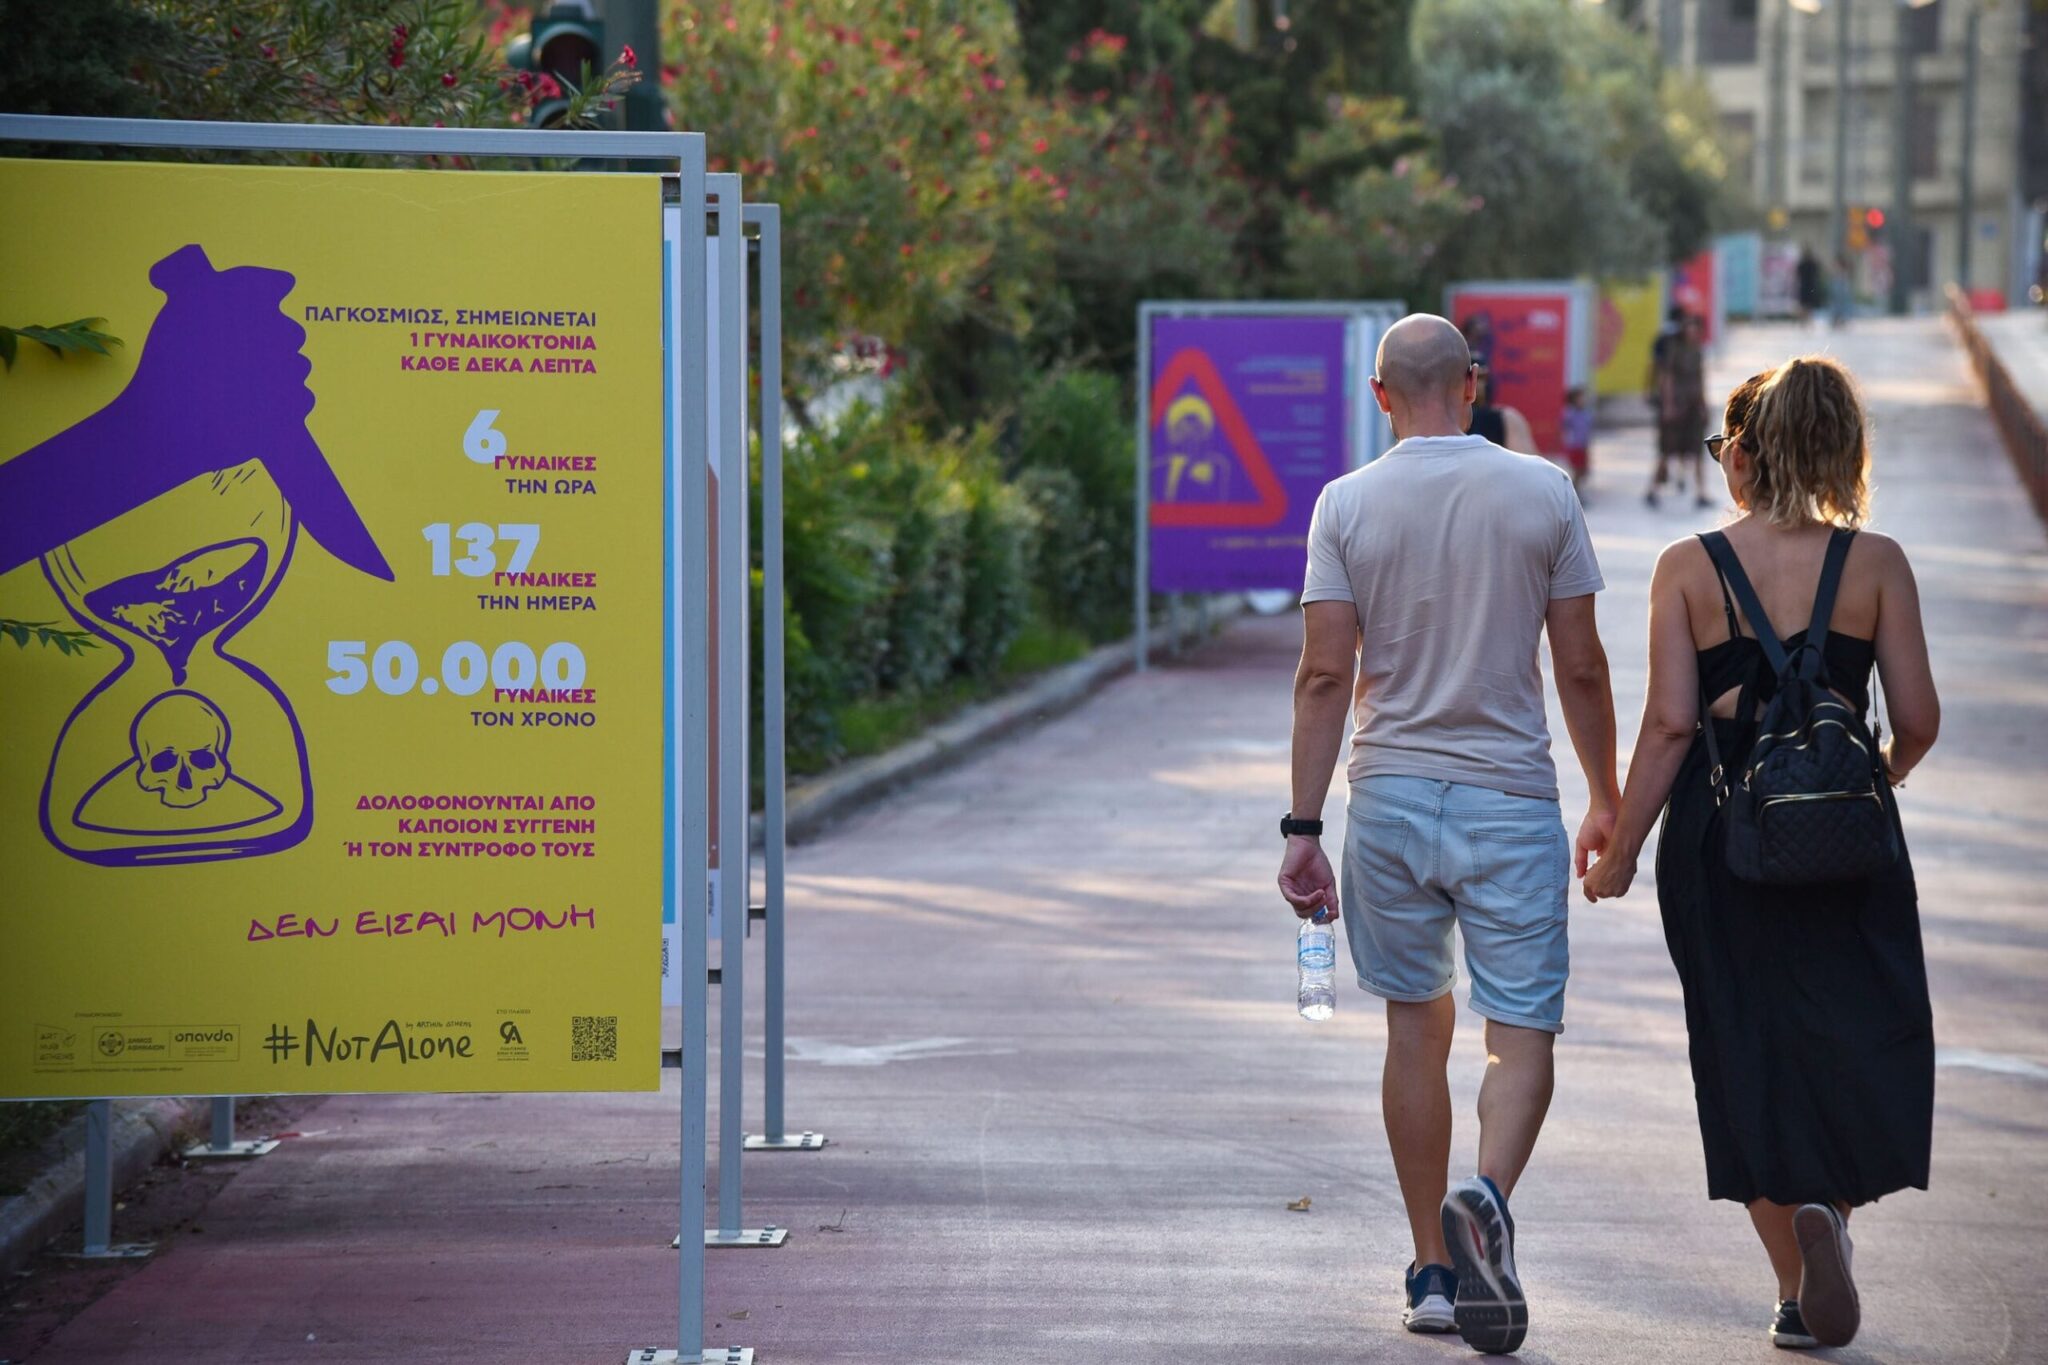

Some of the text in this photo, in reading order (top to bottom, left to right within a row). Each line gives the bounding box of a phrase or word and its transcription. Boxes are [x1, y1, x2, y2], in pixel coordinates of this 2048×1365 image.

[305, 307, 597, 327] ΠΑΓΚΟΣΜΙΩΣ, ΣΗΜΕΙΩΝΕΤΑΙ
[410, 333, 597, 351] 1 ΓΥΝΑΙΚΟΚΤΟΝΙΑ
[401, 357, 597, 374] ΚΑΘΕ ΔΕΚΑ ΛΕΠΤΑ
[463, 410, 507, 464] 6
[494, 456, 597, 471] ΓΥΝΑΙΚΕΣ
[506, 479, 597, 495] ΤΗΝ ΩΡΑ
[421, 522, 540, 577] 137
[494, 572, 596, 587] ΓΥΝΑΙΚΕΣ
[478, 596, 596, 611] ΤΗΝ ΗΜΕΡΑ
[325, 641, 587, 696] 50.000
[494, 689, 596, 703] ΓΥΝΑΙΚΕΣ
[471, 712, 596, 727] ΤΟΝ ΧΡΟΝΟ
[356, 795, 596, 811] ΔΟΛΟΦΟΝΟΥΝΤΑΙ ΑΠΟ
[398, 819, 595, 834] ΚΑΠΟΙΟΝ ΣΥΓΓΕΝΗ
[369, 842, 412, 857] ΤΟΝ
[418, 842, 536, 858] ΣΥΝΤΡΟΦΟ
[542, 843, 596, 857] ΤΟΥΣ
[247, 904, 596, 942] ΔΕΝ ΕΙΣΑΙ ΜΟΝΗ
